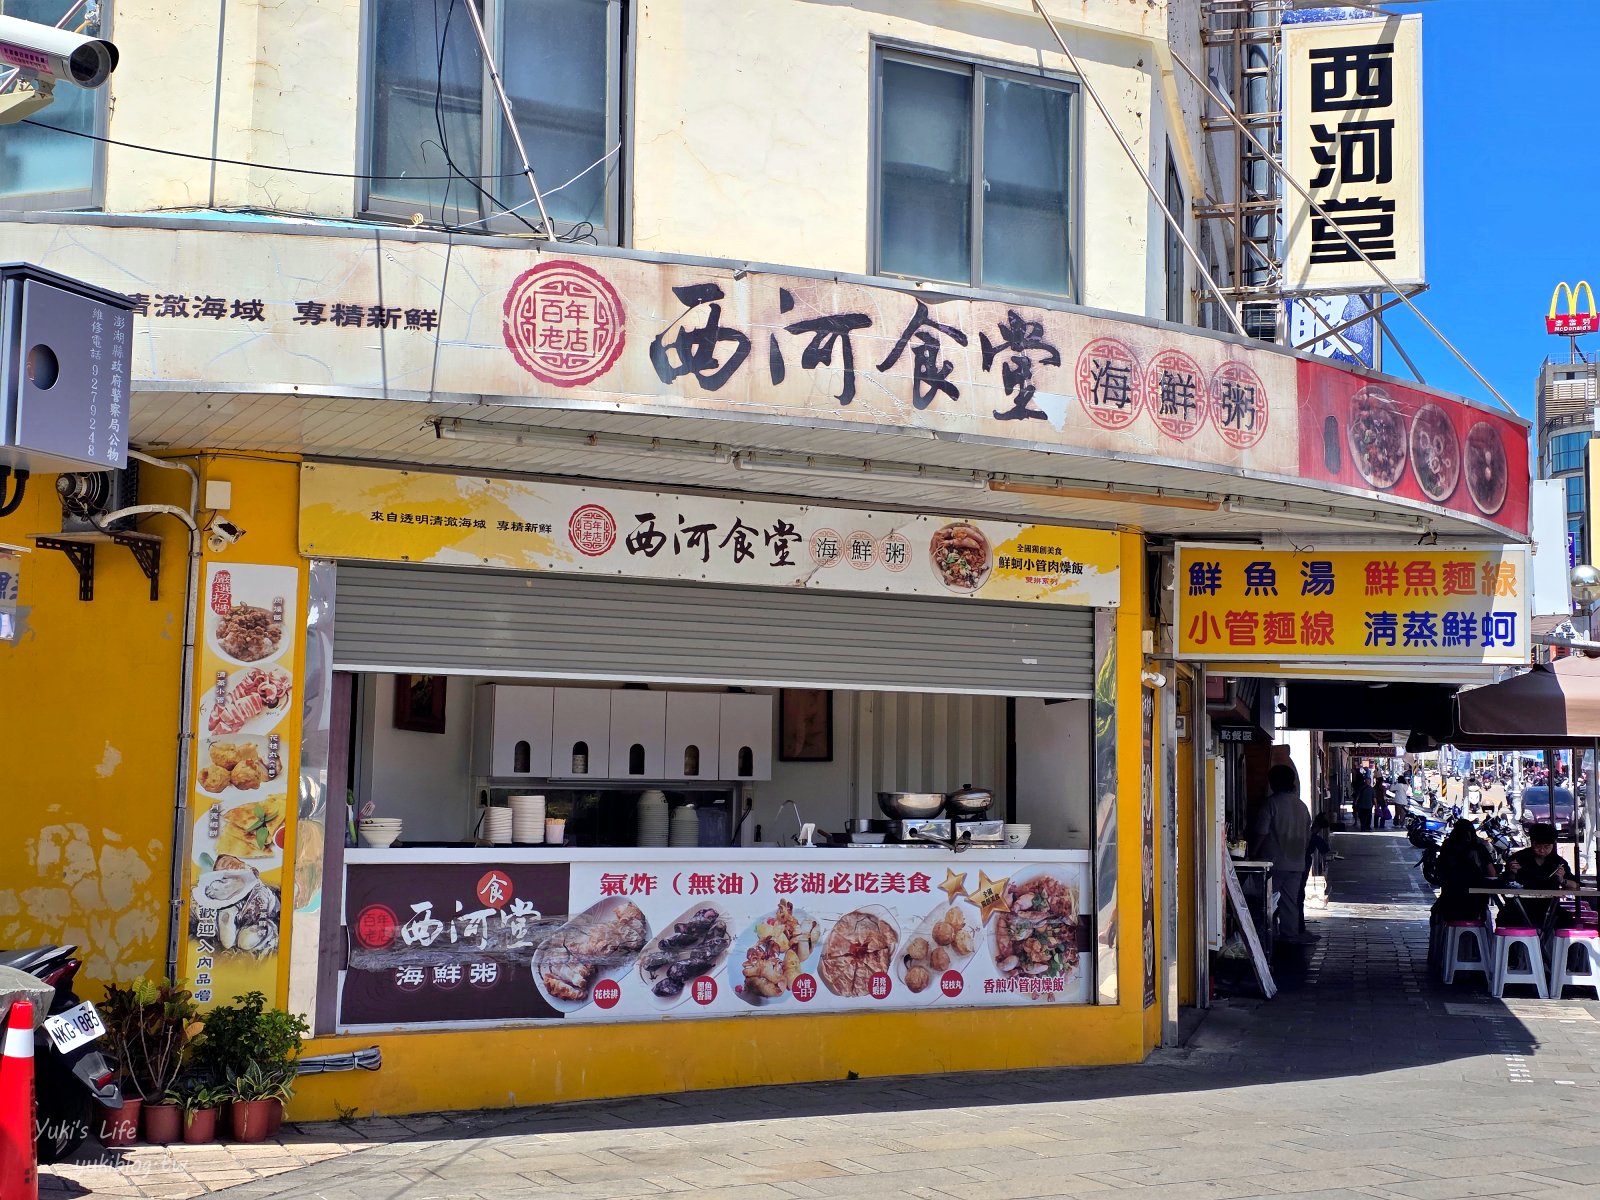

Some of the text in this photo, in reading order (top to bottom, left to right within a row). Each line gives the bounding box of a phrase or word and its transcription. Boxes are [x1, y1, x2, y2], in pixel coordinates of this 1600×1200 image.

[1309, 43, 1396, 265] 西河堂
[292, 300, 438, 332] 專精新鮮
[649, 282, 1061, 421] 西河食堂
[496, 520, 552, 533] 專精新鮮
[626, 512, 803, 567] 西河食堂
[998, 556, 1084, 575] 鮮蚵小管肉燥飯
[1188, 561, 1335, 597] 鮮魚湯
[1188, 610, 1335, 647] 小管麵線
[1364, 611, 1518, 648] 清蒸鮮蚵
[396, 962, 497, 986] 海鮮粥
[983, 978, 1064, 993] 香煎小管肉燥飯
[51, 1010, 100, 1046] NKG-1883
